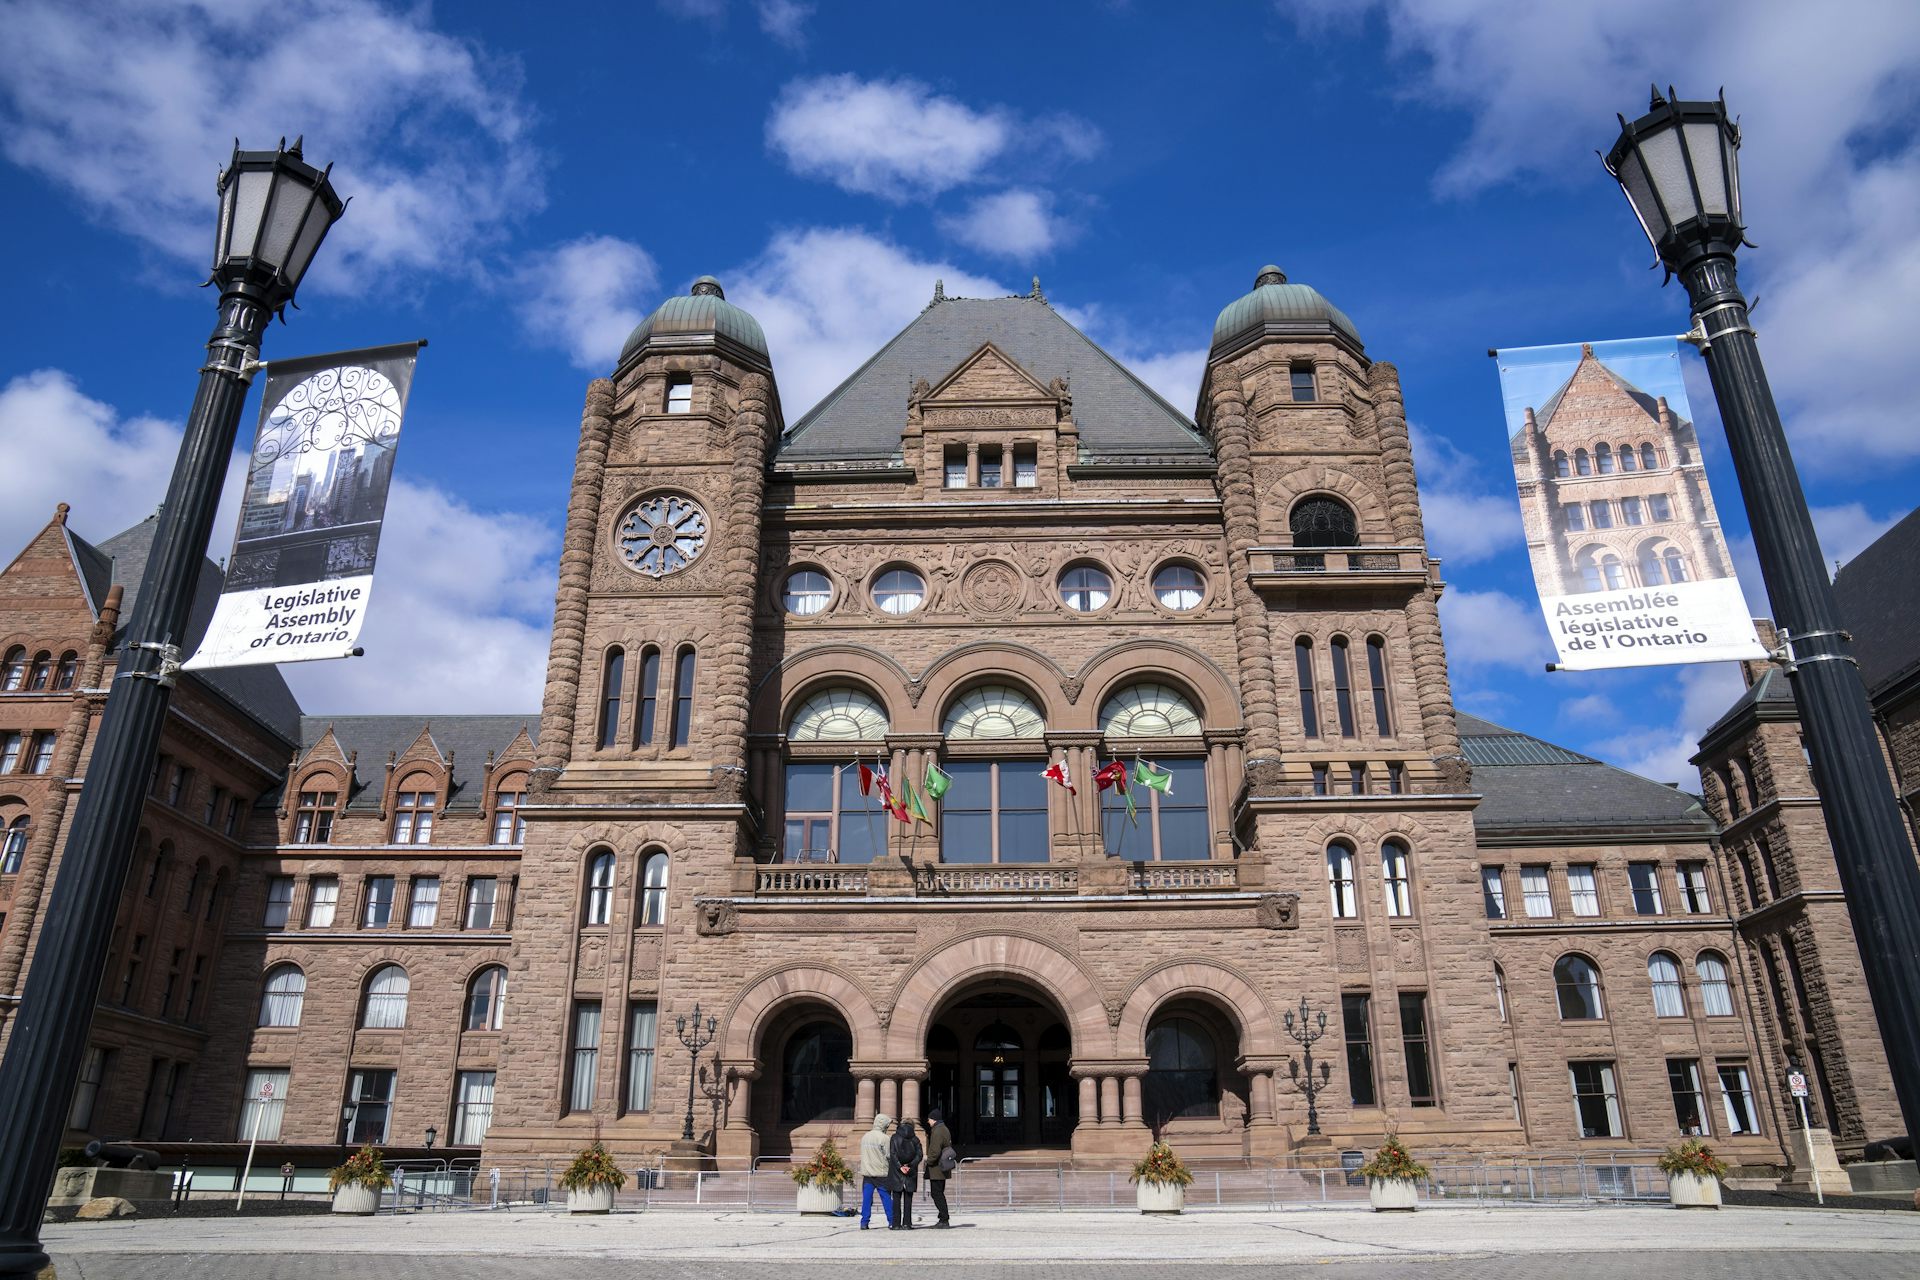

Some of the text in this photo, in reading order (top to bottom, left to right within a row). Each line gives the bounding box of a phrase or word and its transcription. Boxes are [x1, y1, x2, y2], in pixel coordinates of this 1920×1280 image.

[264, 586, 361, 612] Legislative
[1556, 592, 1679, 617] Assemblée
[265, 606, 356, 630] Assembly
[1560, 614, 1679, 636] législative
[250, 627, 349, 649] of Ontario
[1567, 629, 1708, 651] de l'Ontario
